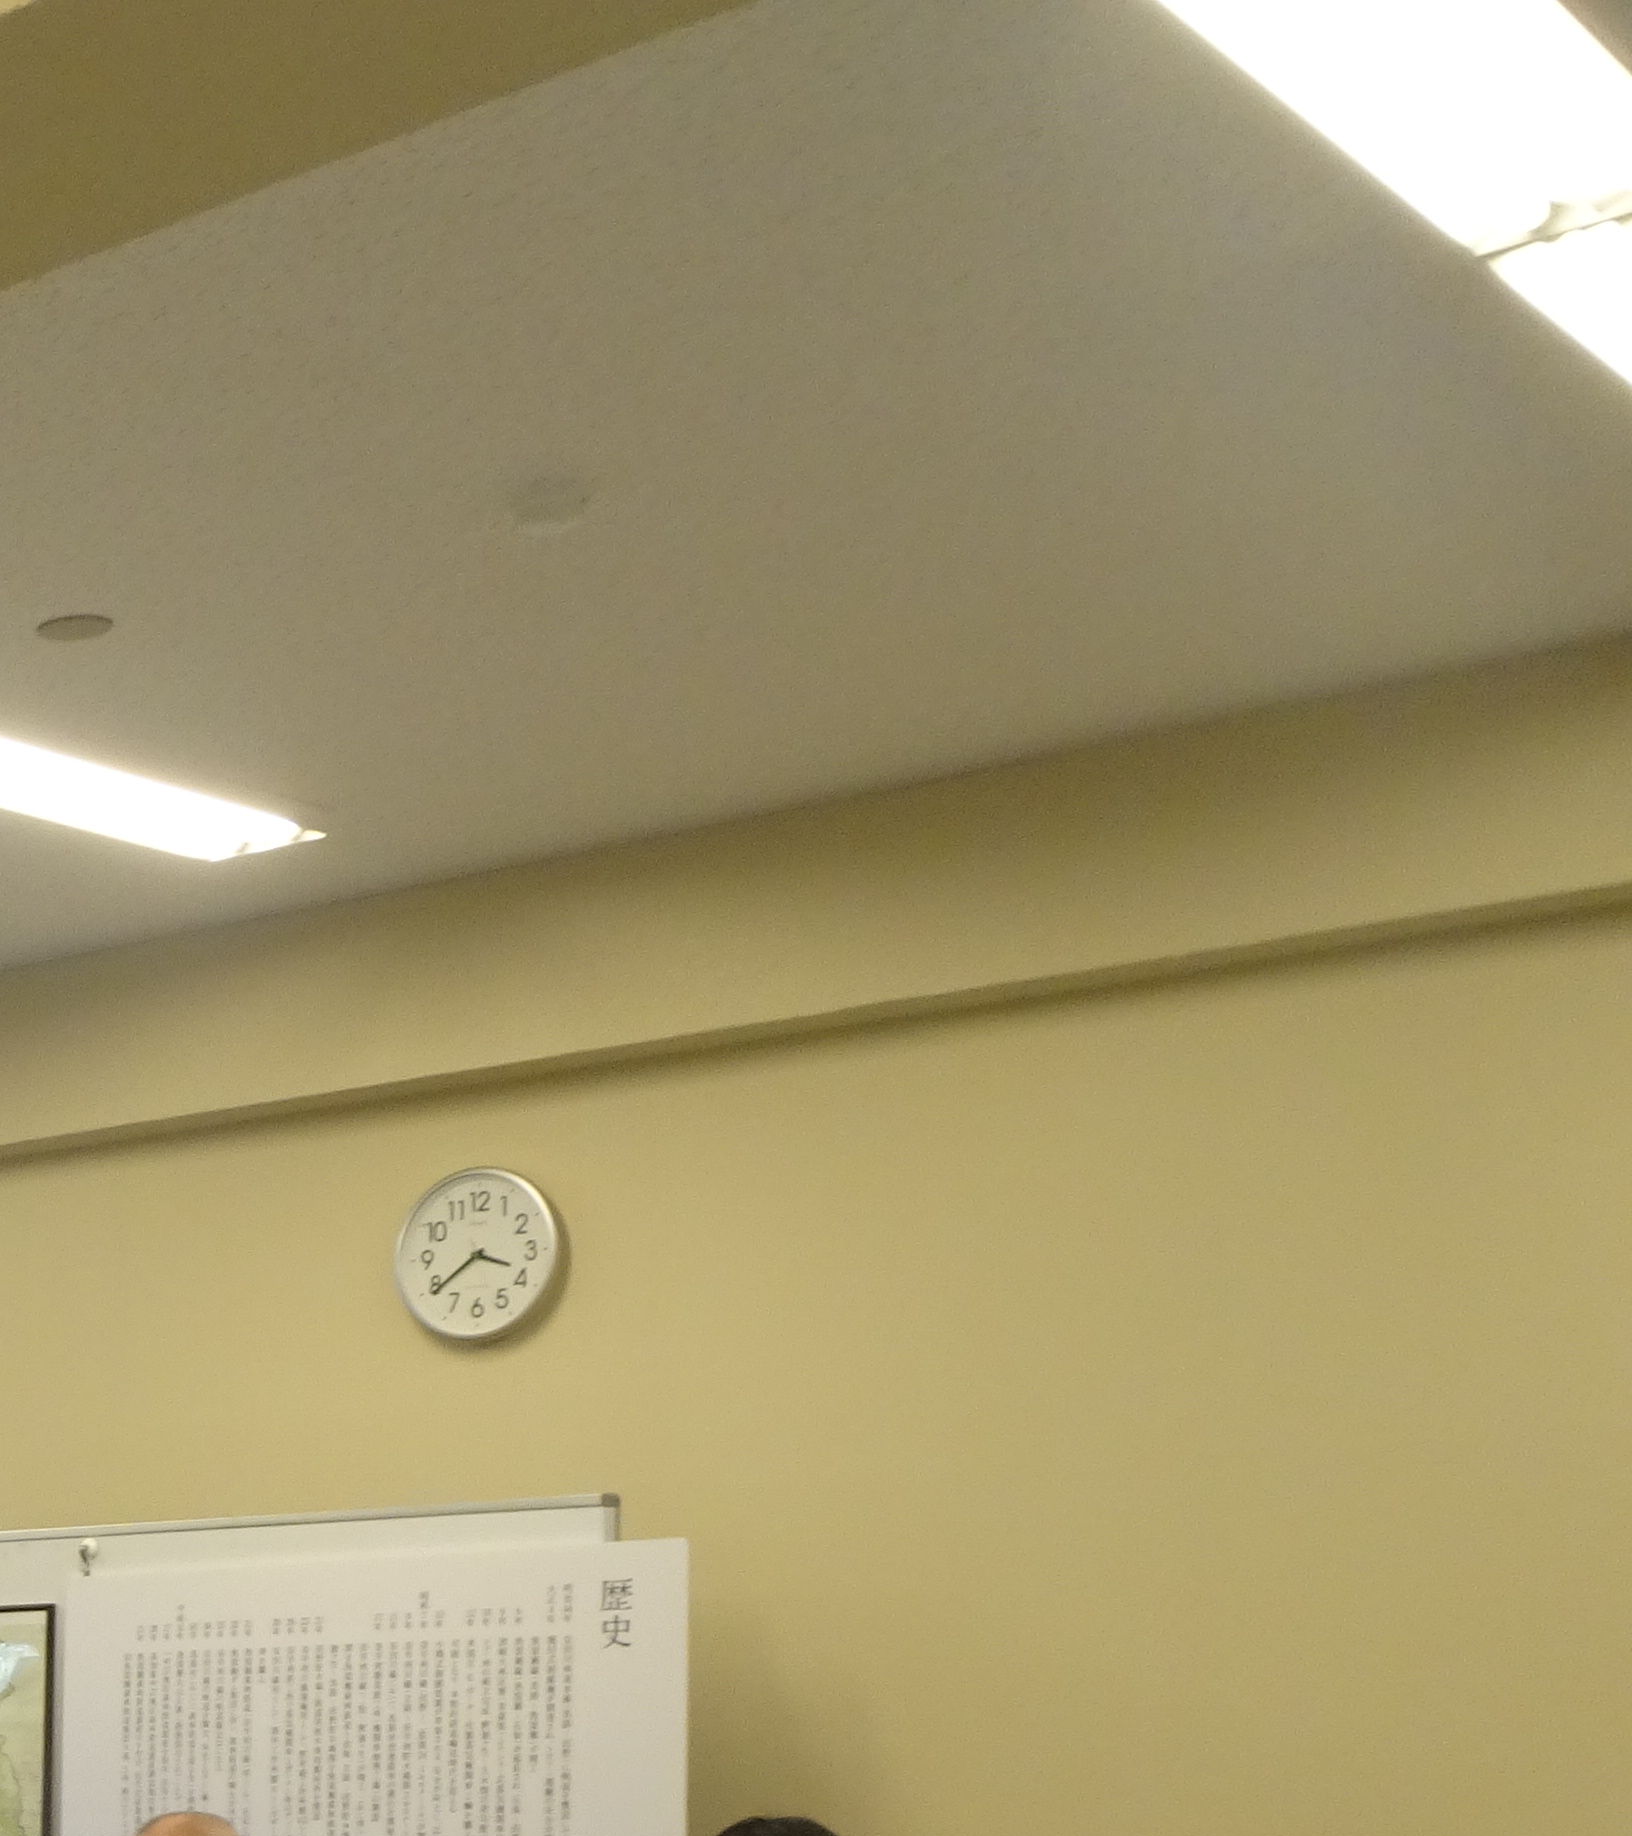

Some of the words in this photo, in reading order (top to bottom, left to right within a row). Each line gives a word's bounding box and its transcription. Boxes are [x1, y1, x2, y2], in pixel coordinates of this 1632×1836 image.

[448, 1200, 465, 1220] 11
[470, 1190, 490, 1212] 12
[501, 1196, 508, 1216] 1
[425, 1221, 447, 1242] 10
[515, 1213, 529, 1235] 2
[421, 1250, 434, 1270] 9
[525, 1240, 537, 1261] 3
[429, 1275, 441, 1295] 8
[514, 1267, 527, 1288] 4
[449, 1292, 460, 1313] 7
[471, 1298, 484, 1318] 6
[495, 1288, 509, 1309] 5
[600, 1577, 634, 1649] 歴史
